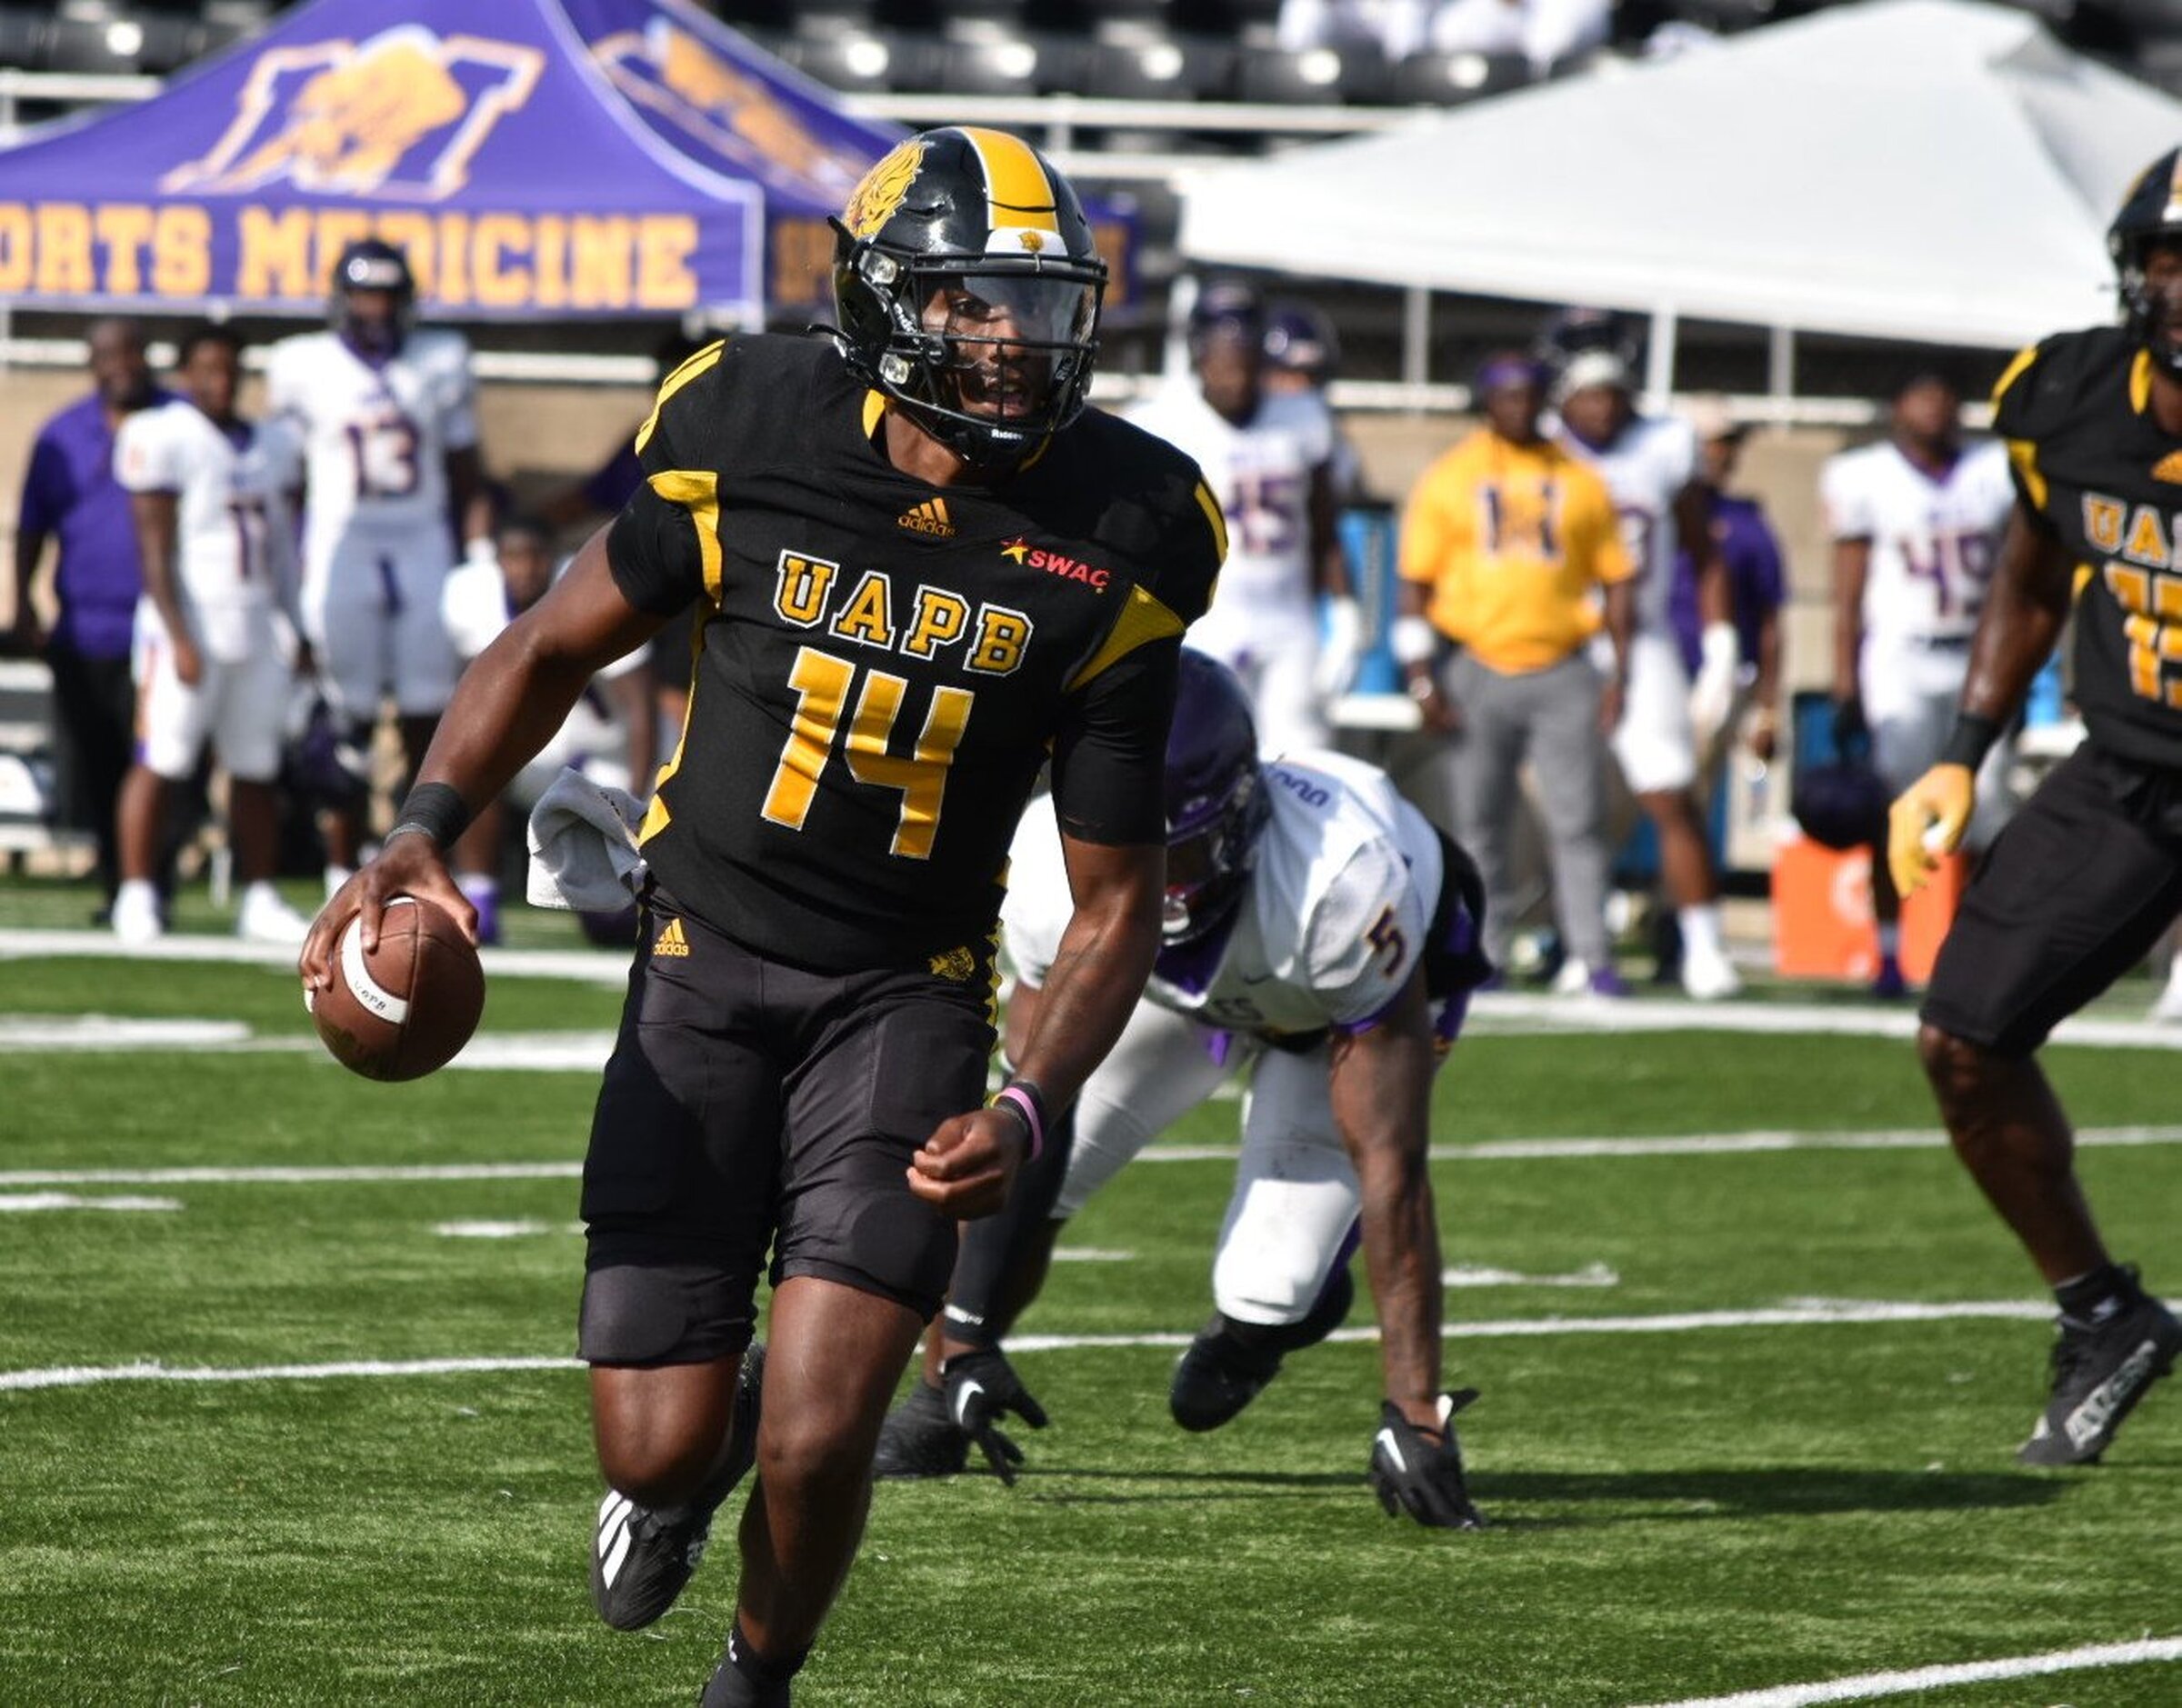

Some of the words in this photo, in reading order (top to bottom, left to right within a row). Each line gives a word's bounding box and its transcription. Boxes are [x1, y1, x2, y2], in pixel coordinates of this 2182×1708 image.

[0, 203, 211, 297] ORTS
[343, 415, 422, 500] 13
[1027, 549, 1110, 588] SWAC
[2082, 491, 2182, 572] UA
[774, 549, 1033, 675] UAPB
[760, 645, 975, 860] 14
[1364, 903, 1407, 978] 5
